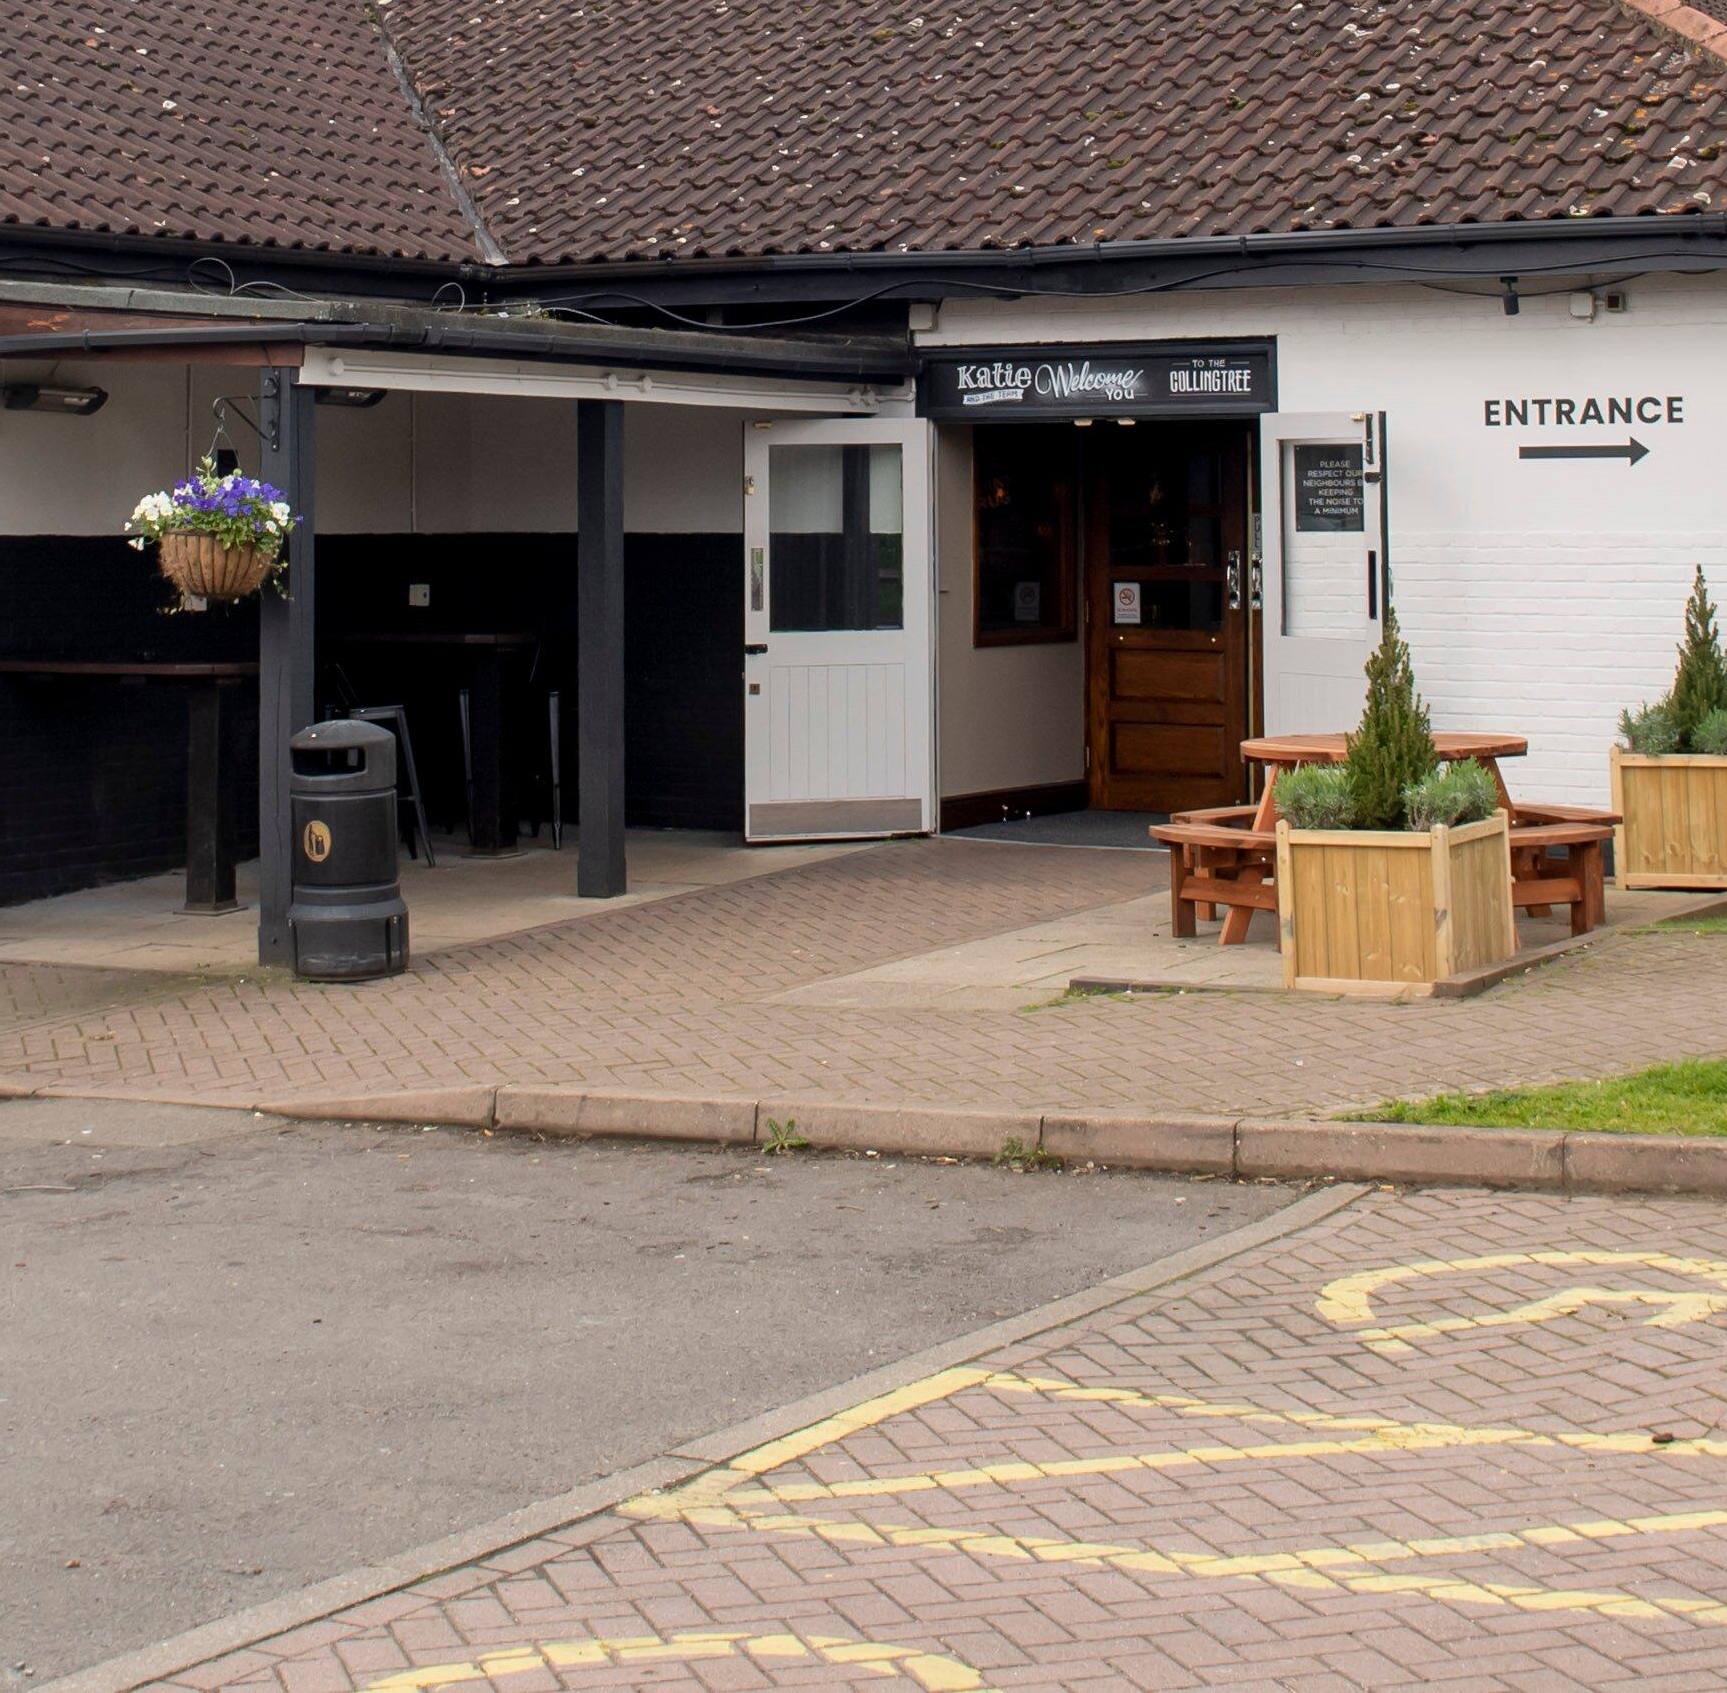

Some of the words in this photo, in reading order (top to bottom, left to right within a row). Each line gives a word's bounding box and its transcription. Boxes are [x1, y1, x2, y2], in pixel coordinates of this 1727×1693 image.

[1192, 359, 1205, 368] TO
[1208, 358, 1226, 367] THE
[957, 362, 1032, 389] Katie
[1035, 361, 1144, 398] Welcome
[1169, 369, 1252, 392] COLLINGTREE
[1484, 396, 1684, 426] ENTRANCE
[1319, 460, 1351, 468] PLEASE
[1345, 469, 1363, 477] OUR
[1302, 479, 1356, 487] NEIGHBOURS
[1318, 488, 1354, 496] KEEPING
[1308, 498, 1325, 506] THE
[1326, 498, 1351, 506] NOISE
[1353, 497, 1364, 505] TO
[1314, 507, 1321, 515] A
[1322, 507, 1359, 515] MINIMUM
